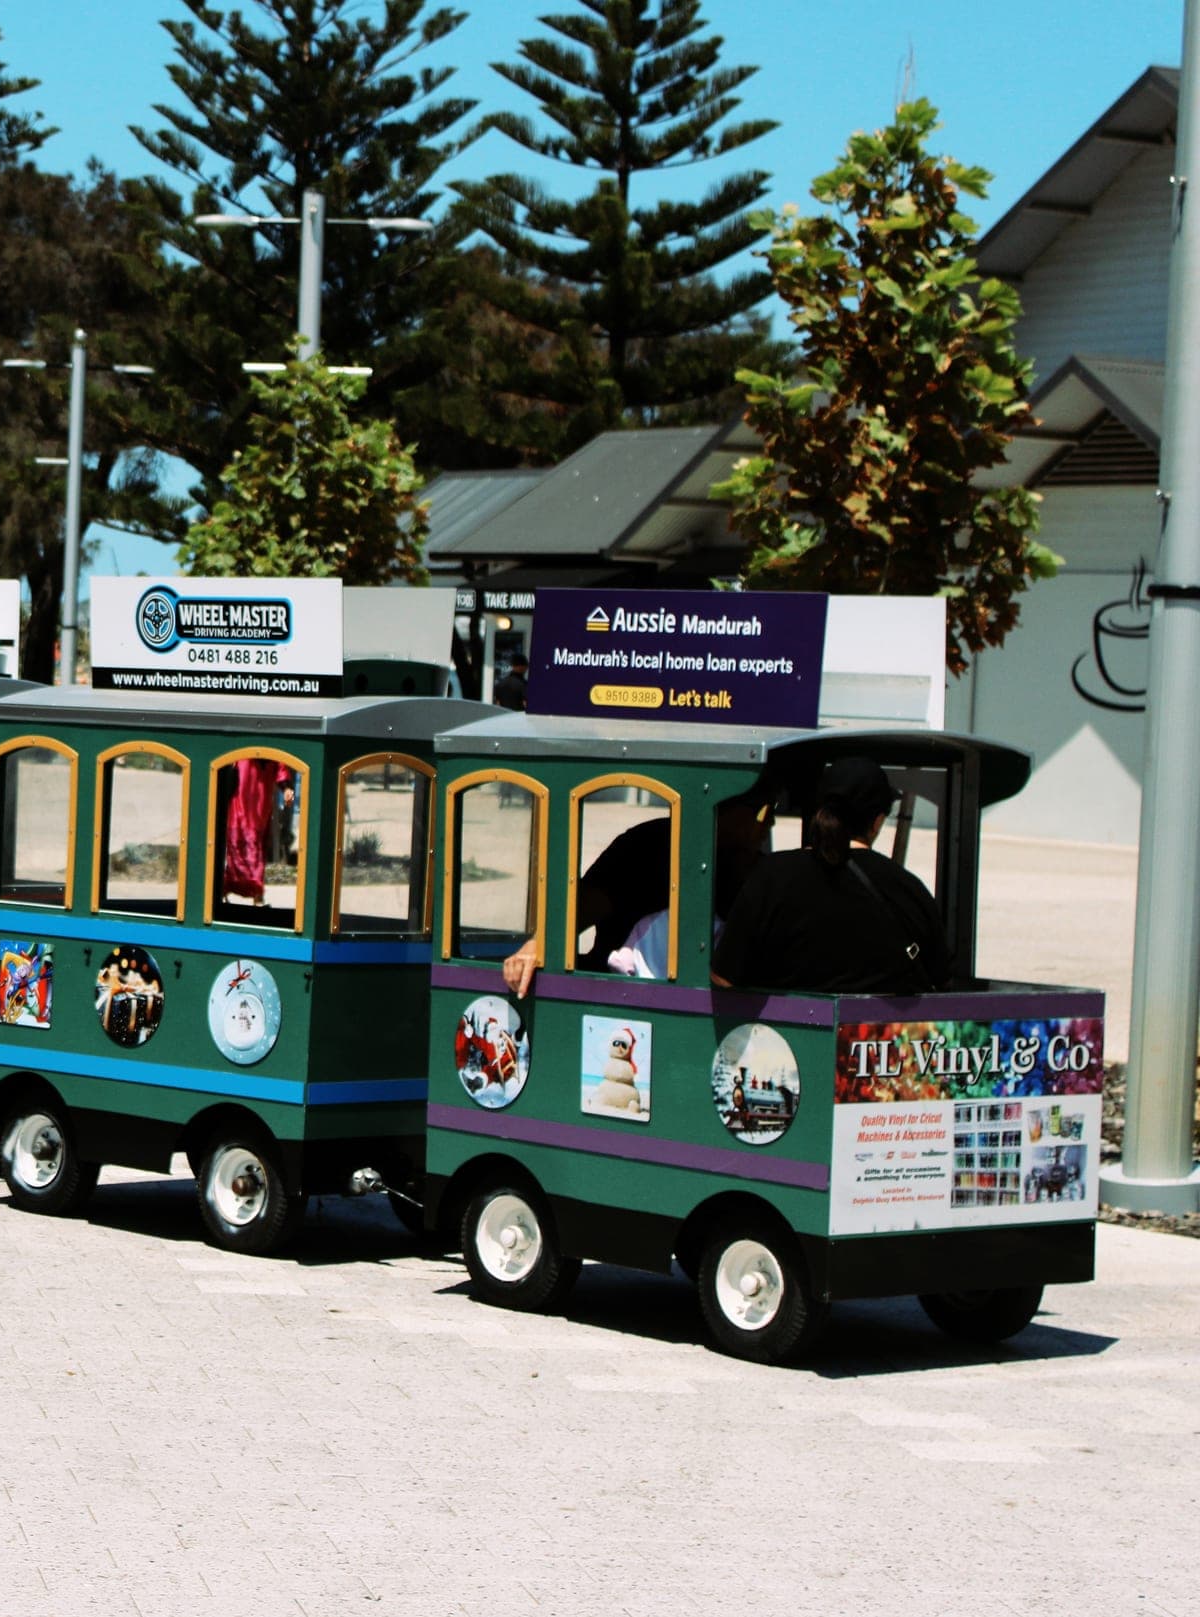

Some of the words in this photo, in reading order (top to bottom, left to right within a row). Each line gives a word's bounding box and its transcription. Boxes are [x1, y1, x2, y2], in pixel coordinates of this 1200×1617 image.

[484, 591, 508, 608] TAKE
[612, 607, 676, 633] Aussie
[682, 615, 762, 636] Mandurah
[194, 627, 229, 637] DRIVING
[230, 628, 272, 638] ACADEMY
[188, 648, 220, 663] 0481
[225, 649, 251, 664] 488
[255, 650, 278, 665] 216
[554, 647, 628, 668] Mandurah's
[631, 649, 664, 670] local
[665, 651, 704, 671] home
[706, 652, 737, 672] loan
[739, 657, 794, 677] experts
[112, 672, 320, 694] www.wheelmasterdriving.com.au
[606, 690, 629, 702] 9510
[669, 687, 701, 708] Let's
[704, 689, 732, 709] talk
[851, 1040, 902, 1077] TL
[910, 1035, 1001, 1085] Vinyl
[1010, 1037, 1040, 1074] &
[1047, 1035, 1090, 1072] Co
[861, 1115, 887, 1127] Quality
[888, 1113, 907, 1126] Vinyl
[908, 1113, 919, 1124] for
[920, 1112, 942, 1124] Cricut
[857, 1131, 893, 1142] Machines
[903, 1129, 946, 1141] Accessories
